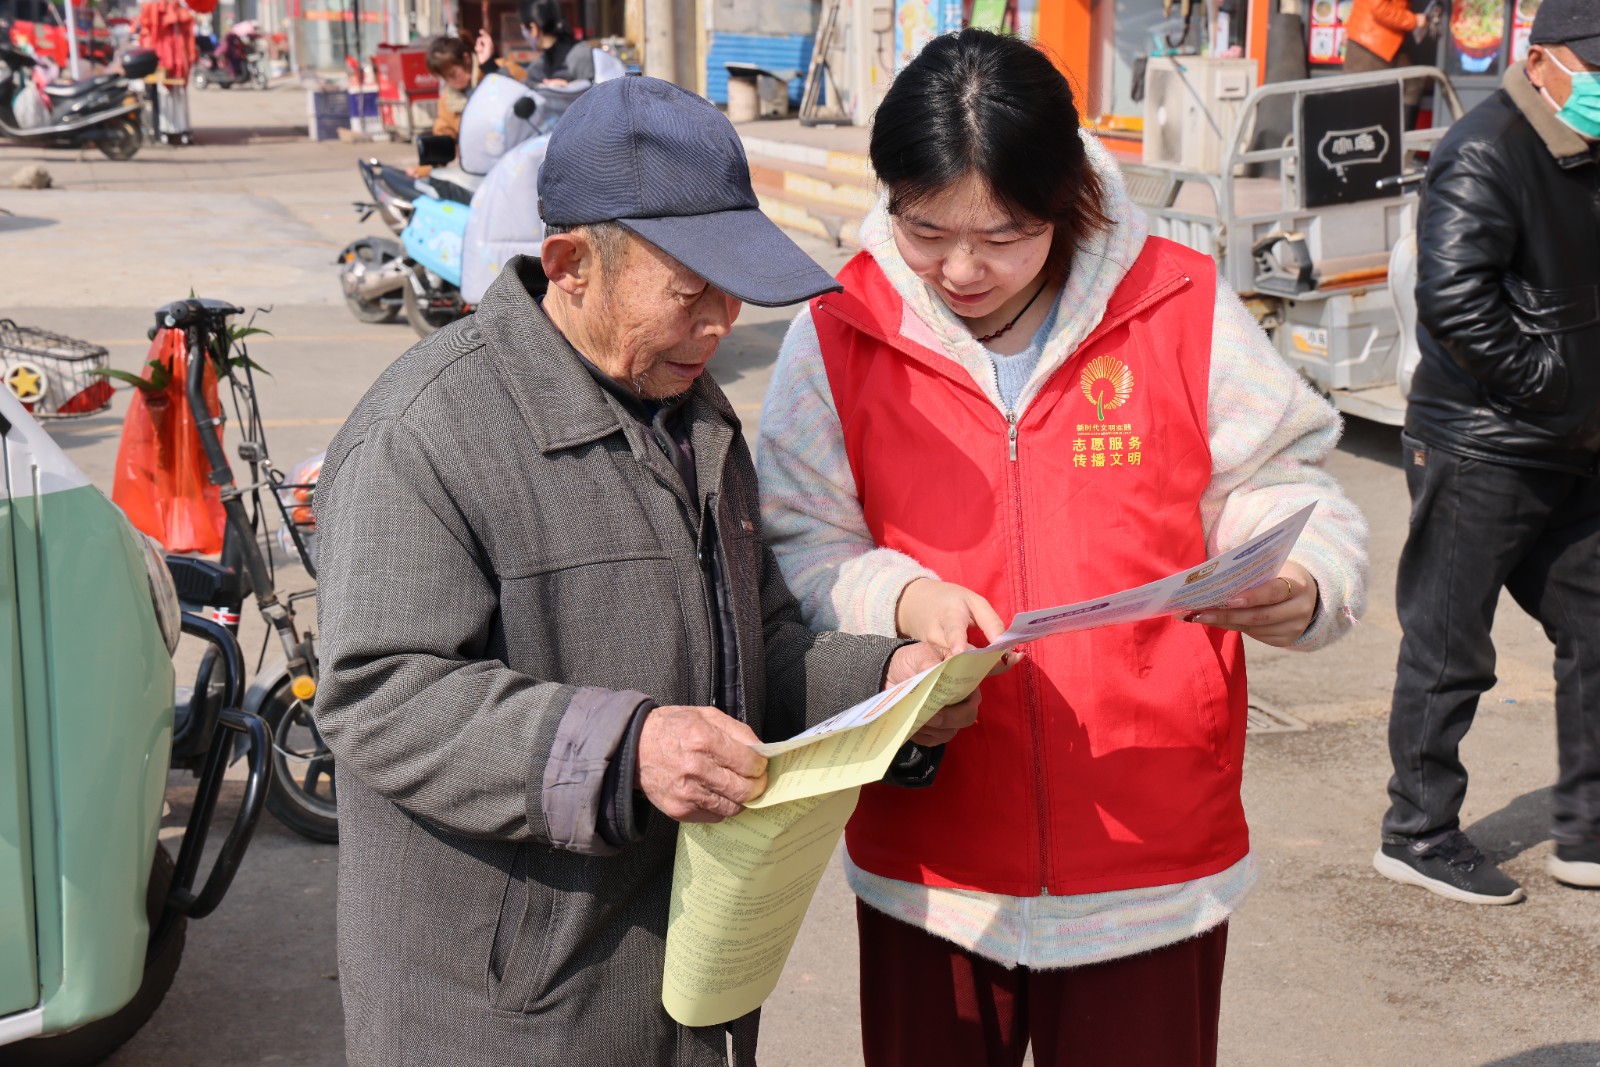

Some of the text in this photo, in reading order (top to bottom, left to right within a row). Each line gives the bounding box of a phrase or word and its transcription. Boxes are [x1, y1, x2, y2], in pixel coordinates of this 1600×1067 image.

[1076, 423, 1132, 432] 新时代文明实践
[1072, 436, 1142, 452] 志愿服务
[1072, 452, 1142, 468] 传播文明
